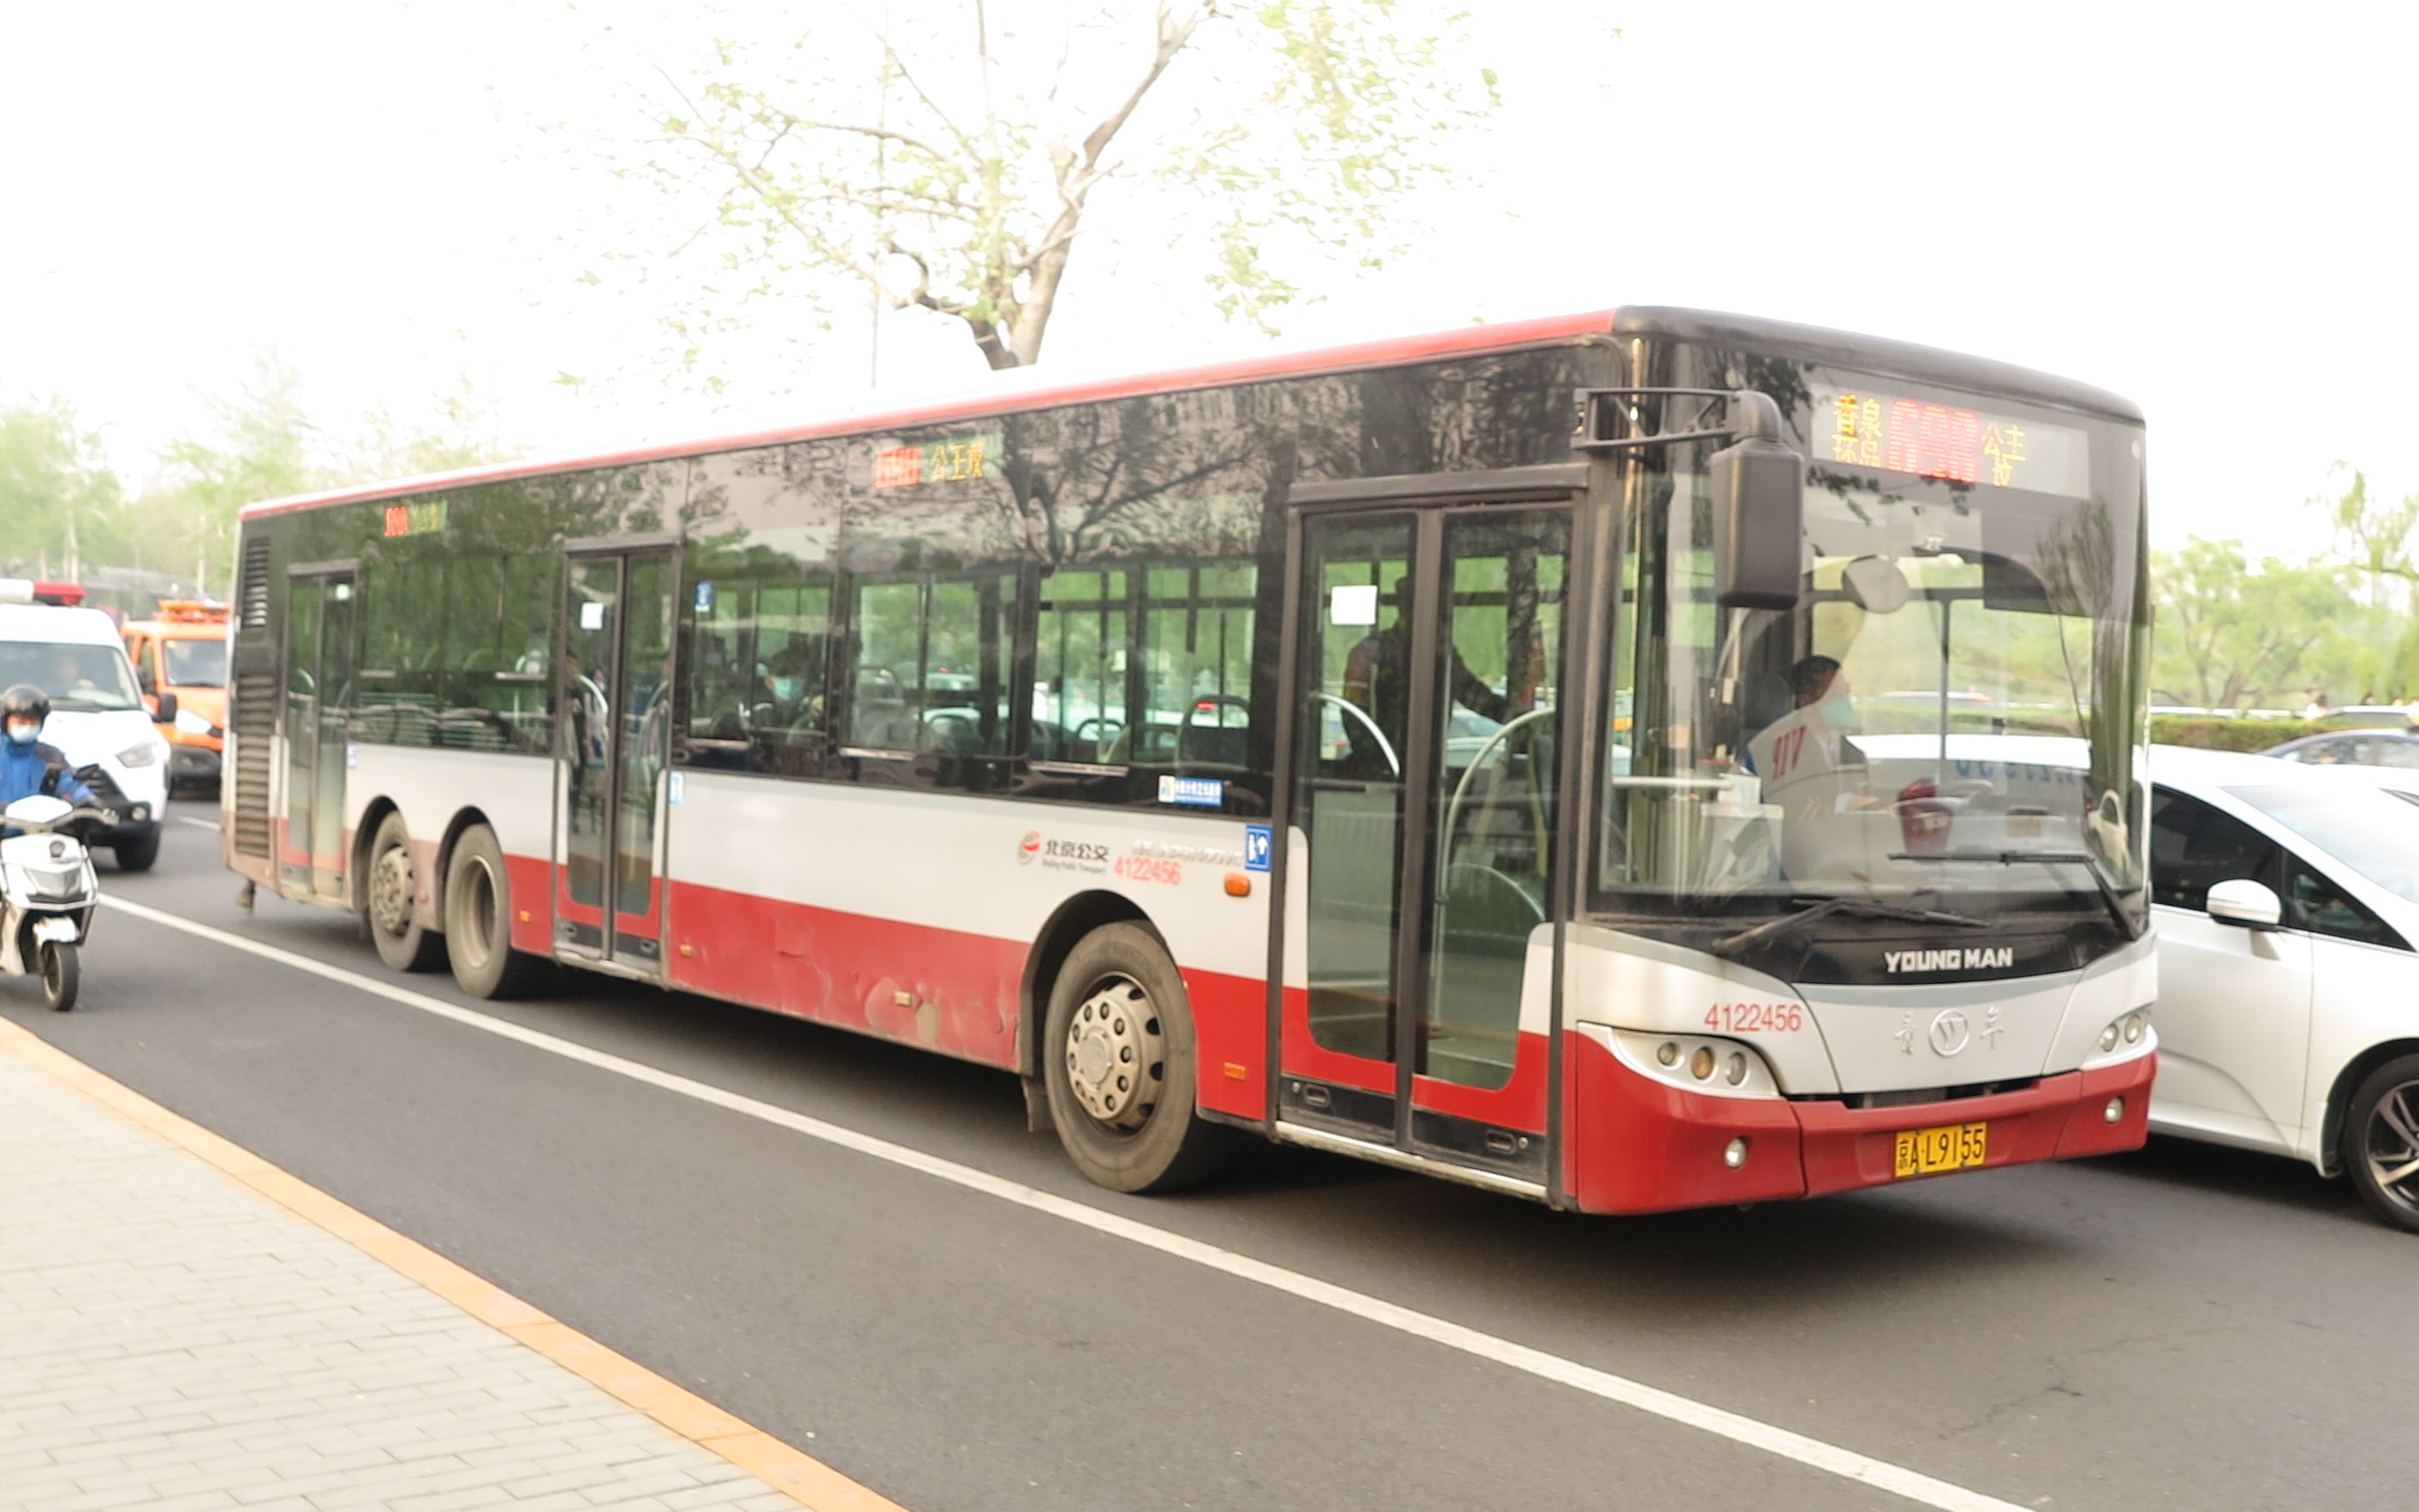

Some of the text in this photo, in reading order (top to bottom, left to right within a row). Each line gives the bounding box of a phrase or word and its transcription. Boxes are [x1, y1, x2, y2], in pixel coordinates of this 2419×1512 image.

[1046, 838, 1110, 863] 北京公交
[1114, 855, 1182, 885] 4122456
[1885, 947, 2014, 973] YOUNG MAN
[1704, 1003, 1802, 1033] 4122456
